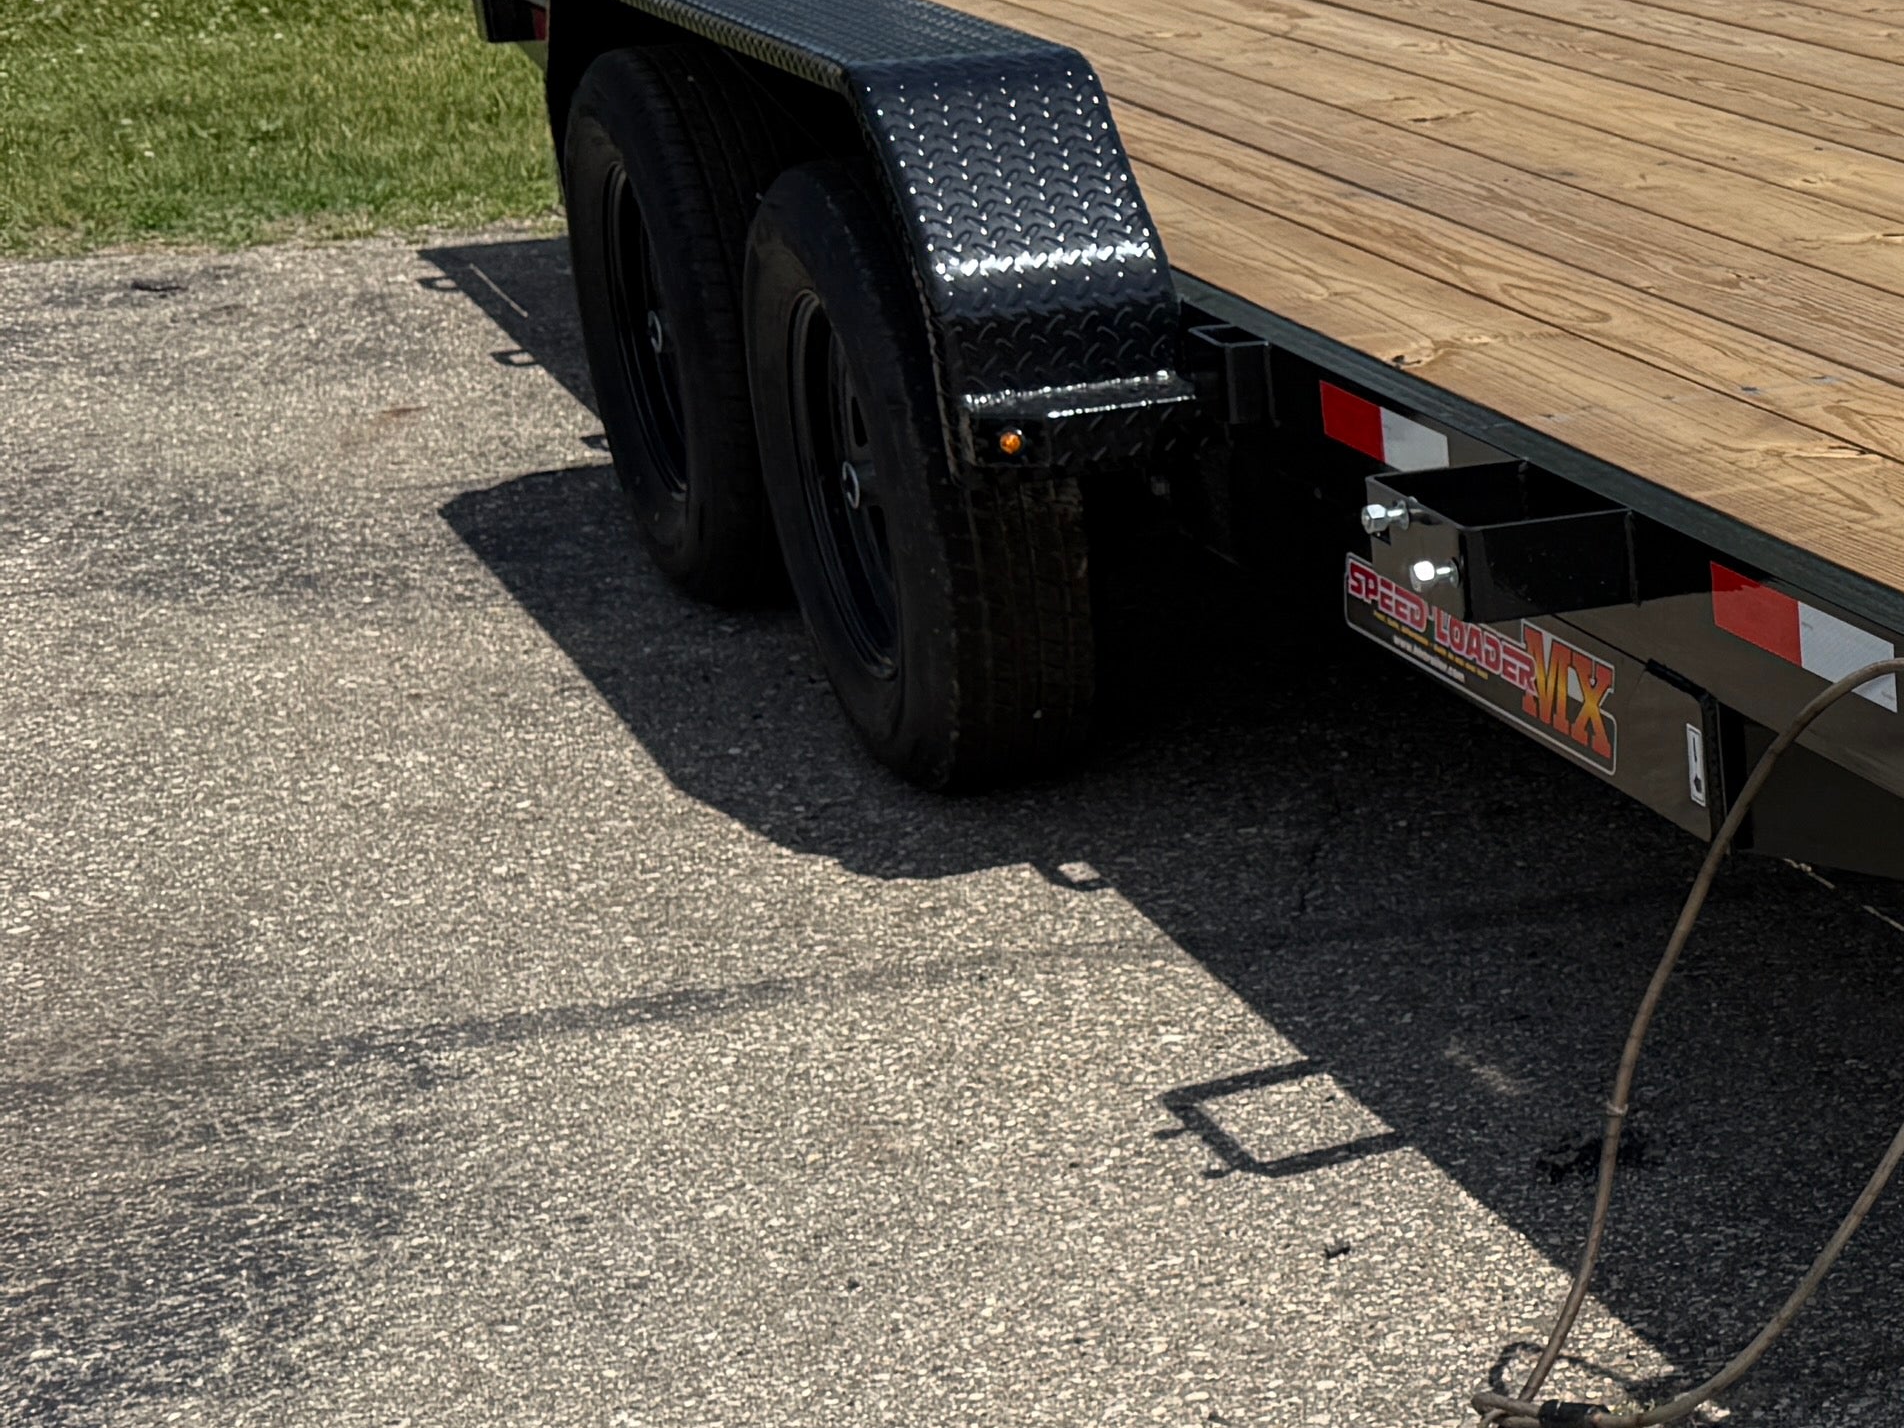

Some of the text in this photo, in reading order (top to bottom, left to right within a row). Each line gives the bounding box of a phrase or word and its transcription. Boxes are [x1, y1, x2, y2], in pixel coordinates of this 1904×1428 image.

[1348, 560, 1428, 632] SPEED
[1433, 605, 1539, 697] LOADER
[1522, 624, 1613, 760] MX
